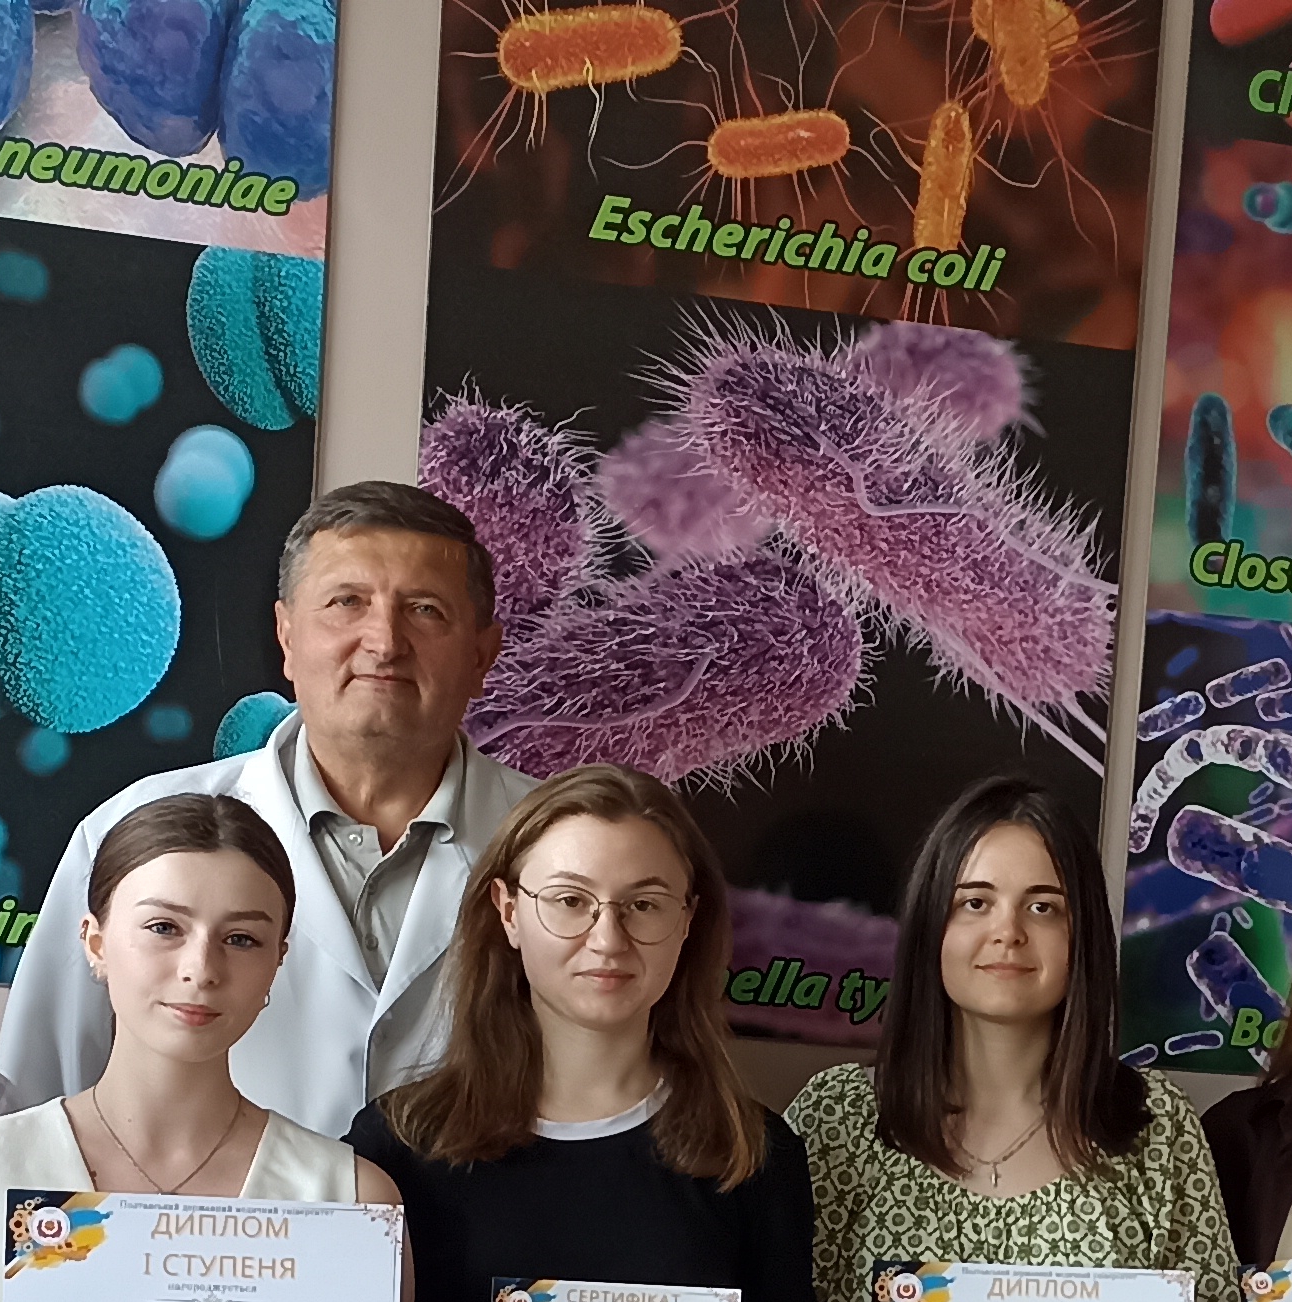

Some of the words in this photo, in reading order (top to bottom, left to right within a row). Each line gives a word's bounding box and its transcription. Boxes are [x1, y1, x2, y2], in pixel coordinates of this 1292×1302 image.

[589, 194, 898, 278] Escherichia
[907, 244, 1007, 291] coli
[150, 1212, 290, 1240] ДИПЛОМ
[162, 1253, 297, 1280] СТУПЕНЯ
[987, 1277, 1100, 1300] ДИПЛОМ
